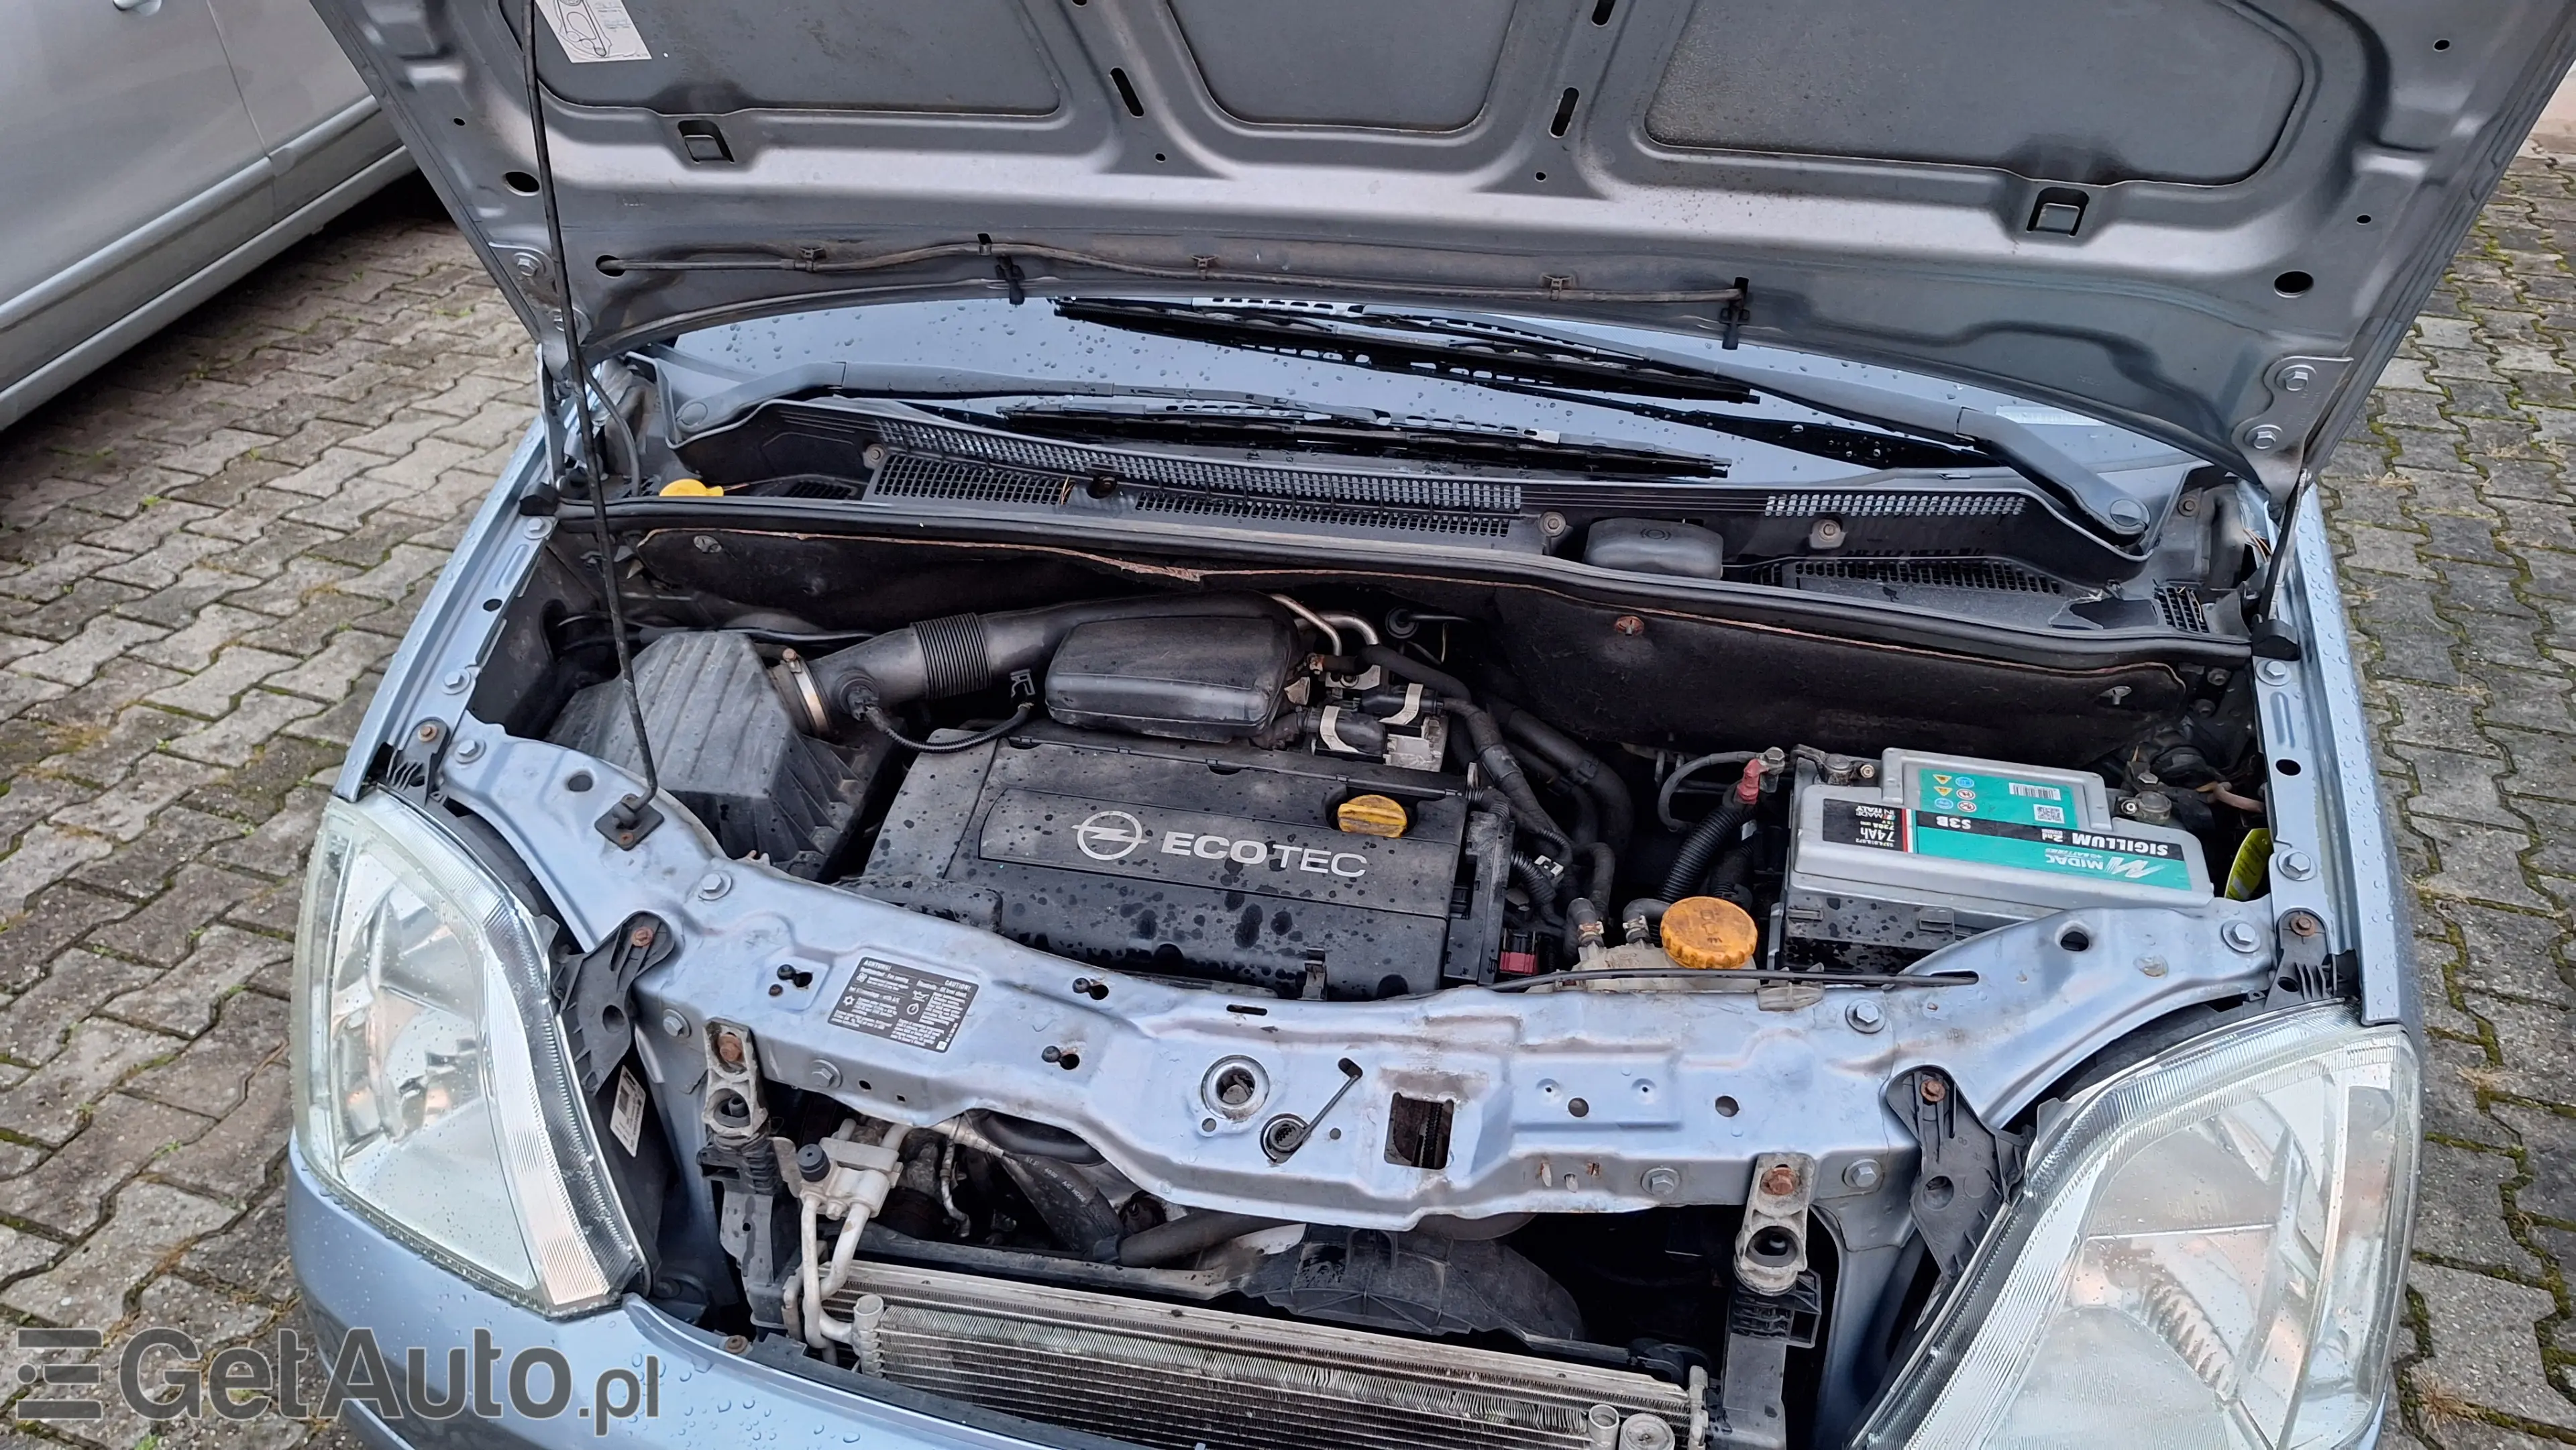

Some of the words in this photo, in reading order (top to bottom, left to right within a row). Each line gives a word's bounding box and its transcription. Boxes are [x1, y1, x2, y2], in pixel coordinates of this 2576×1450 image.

[1936, 816, 1972, 829] S3B
[1860, 827, 1895, 842] 74Ah
[2072, 833, 2168, 856] SIGILLUM
[1161, 831, 1368, 878] ECOTEC
[2045, 854, 2104, 870] MIDAC
